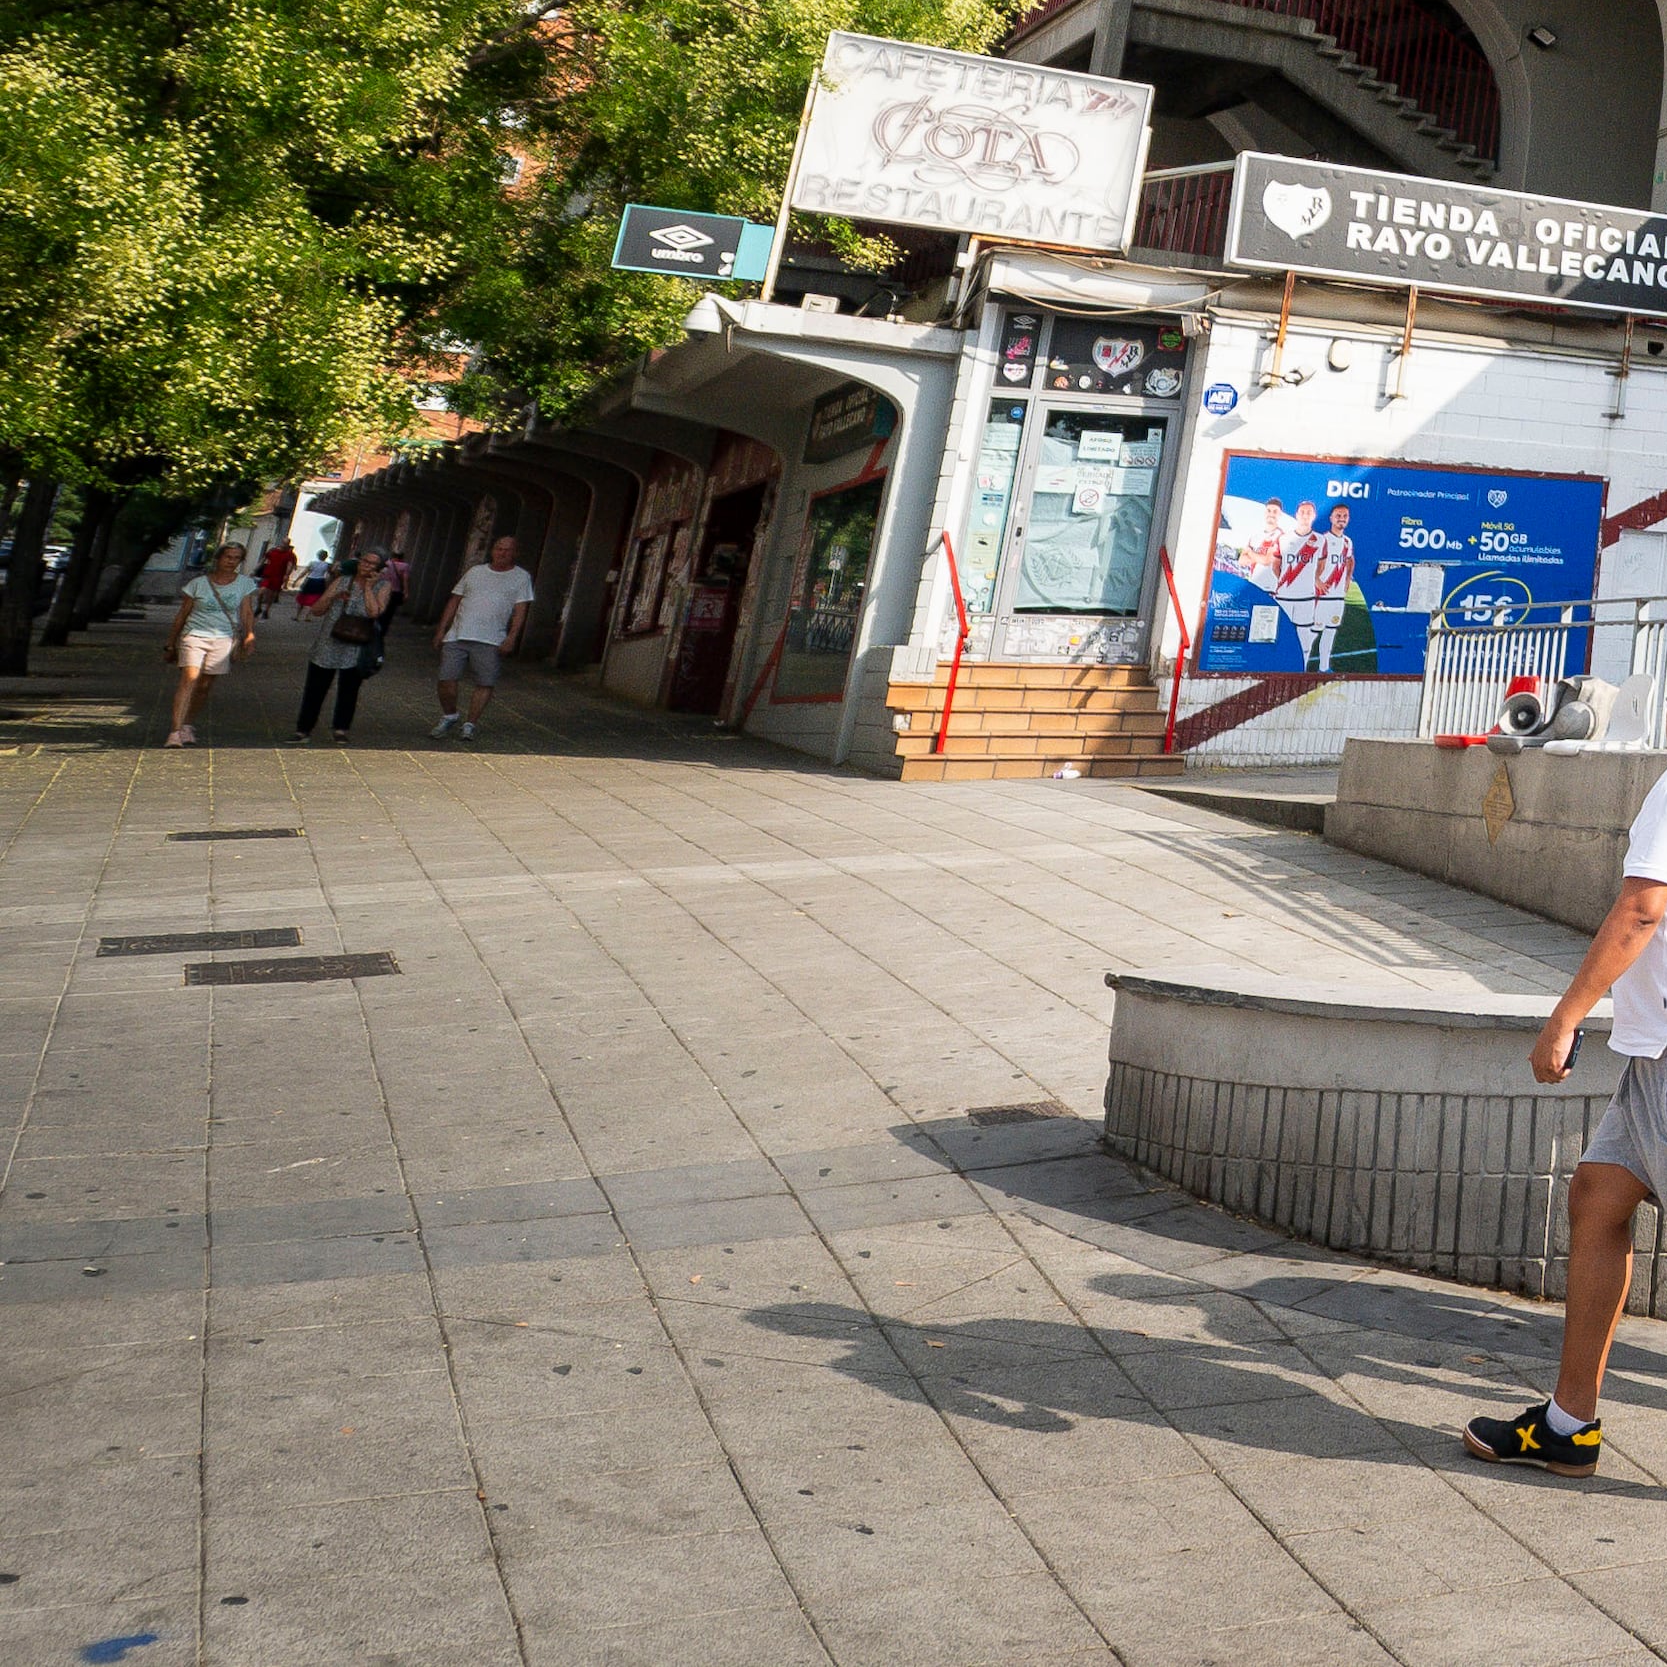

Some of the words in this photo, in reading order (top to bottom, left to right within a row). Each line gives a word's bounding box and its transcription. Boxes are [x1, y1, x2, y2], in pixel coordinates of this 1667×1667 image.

[802, 172, 1123, 243] RESTAURANTE
[1350, 190, 1500, 237] TIENDA
[1346, 221, 1451, 260] RAYO
[651, 248, 704, 263] umbro
[1326, 479, 1370, 499] DIGI
[1401, 516, 1423, 527] Fibra
[1399, 527, 1446, 550] 500
[1446, 540, 1463, 551] Mb
[1479, 531, 1510, 552] 50
[1510, 533, 1528, 545] GB
[1286, 553, 1314, 565] DIGI
[1478, 553, 1521, 564] Llamadas
[1521, 555, 1565, 566] ilimitadas
